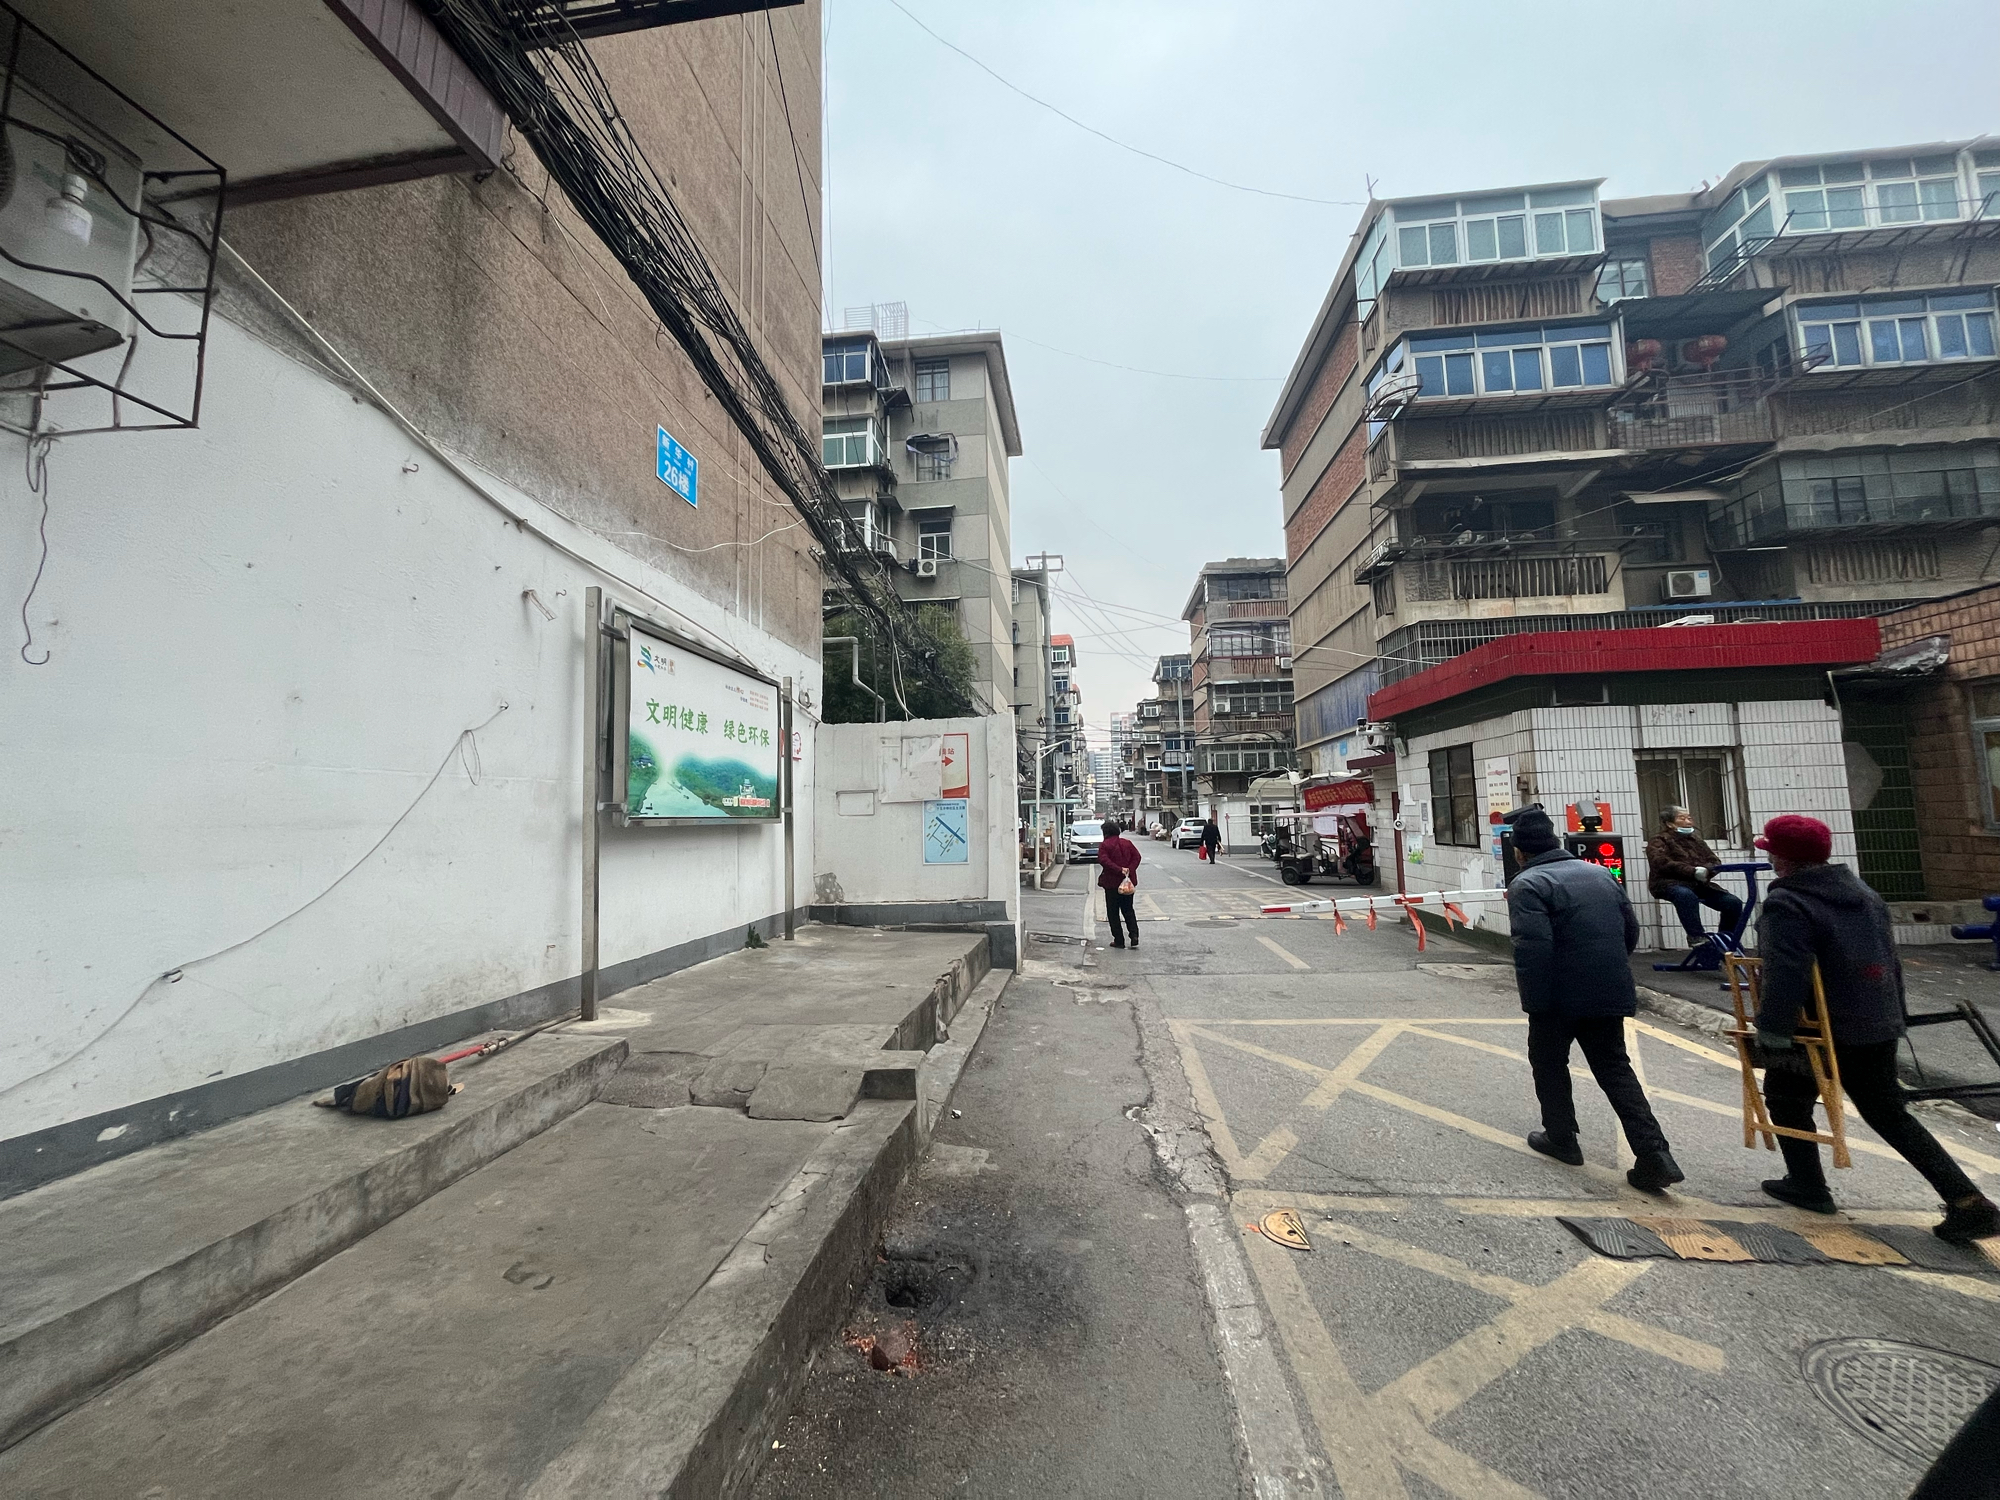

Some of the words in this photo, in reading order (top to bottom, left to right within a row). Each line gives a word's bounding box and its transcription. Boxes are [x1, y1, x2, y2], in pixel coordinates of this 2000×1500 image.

[663, 459, 690, 497] 26楼
[645, 698, 709, 735] 文明健康
[723, 719, 770, 747] 绿色环保
[1577, 843, 1587, 856] P
